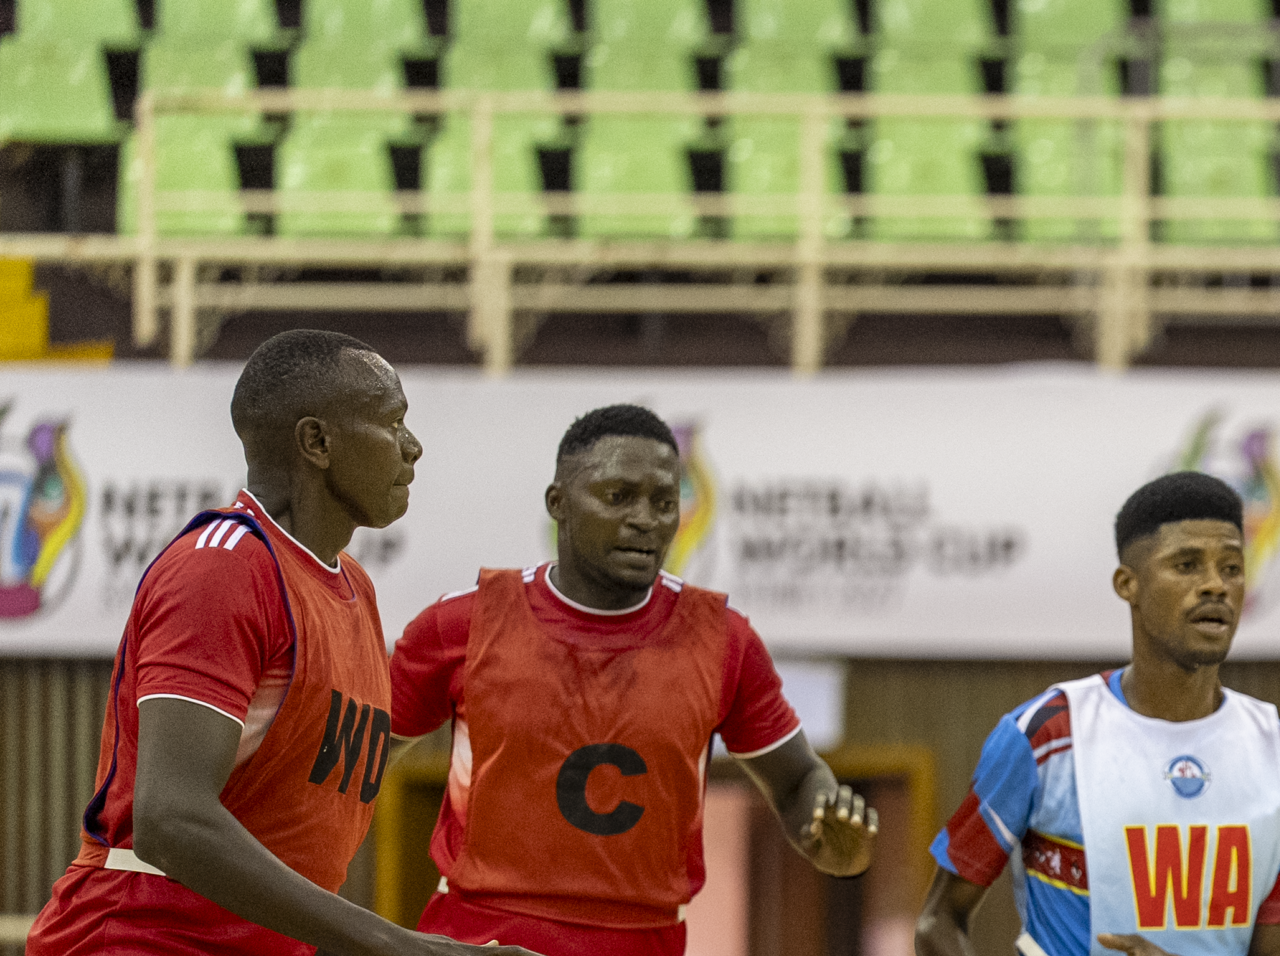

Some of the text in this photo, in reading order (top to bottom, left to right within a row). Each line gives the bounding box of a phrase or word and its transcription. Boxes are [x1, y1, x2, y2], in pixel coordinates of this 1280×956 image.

[100, 478, 238, 524] NETB
[308, 689, 390, 804] WD
[556, 742, 648, 836] C
[1124, 823, 1253, 931] WA
